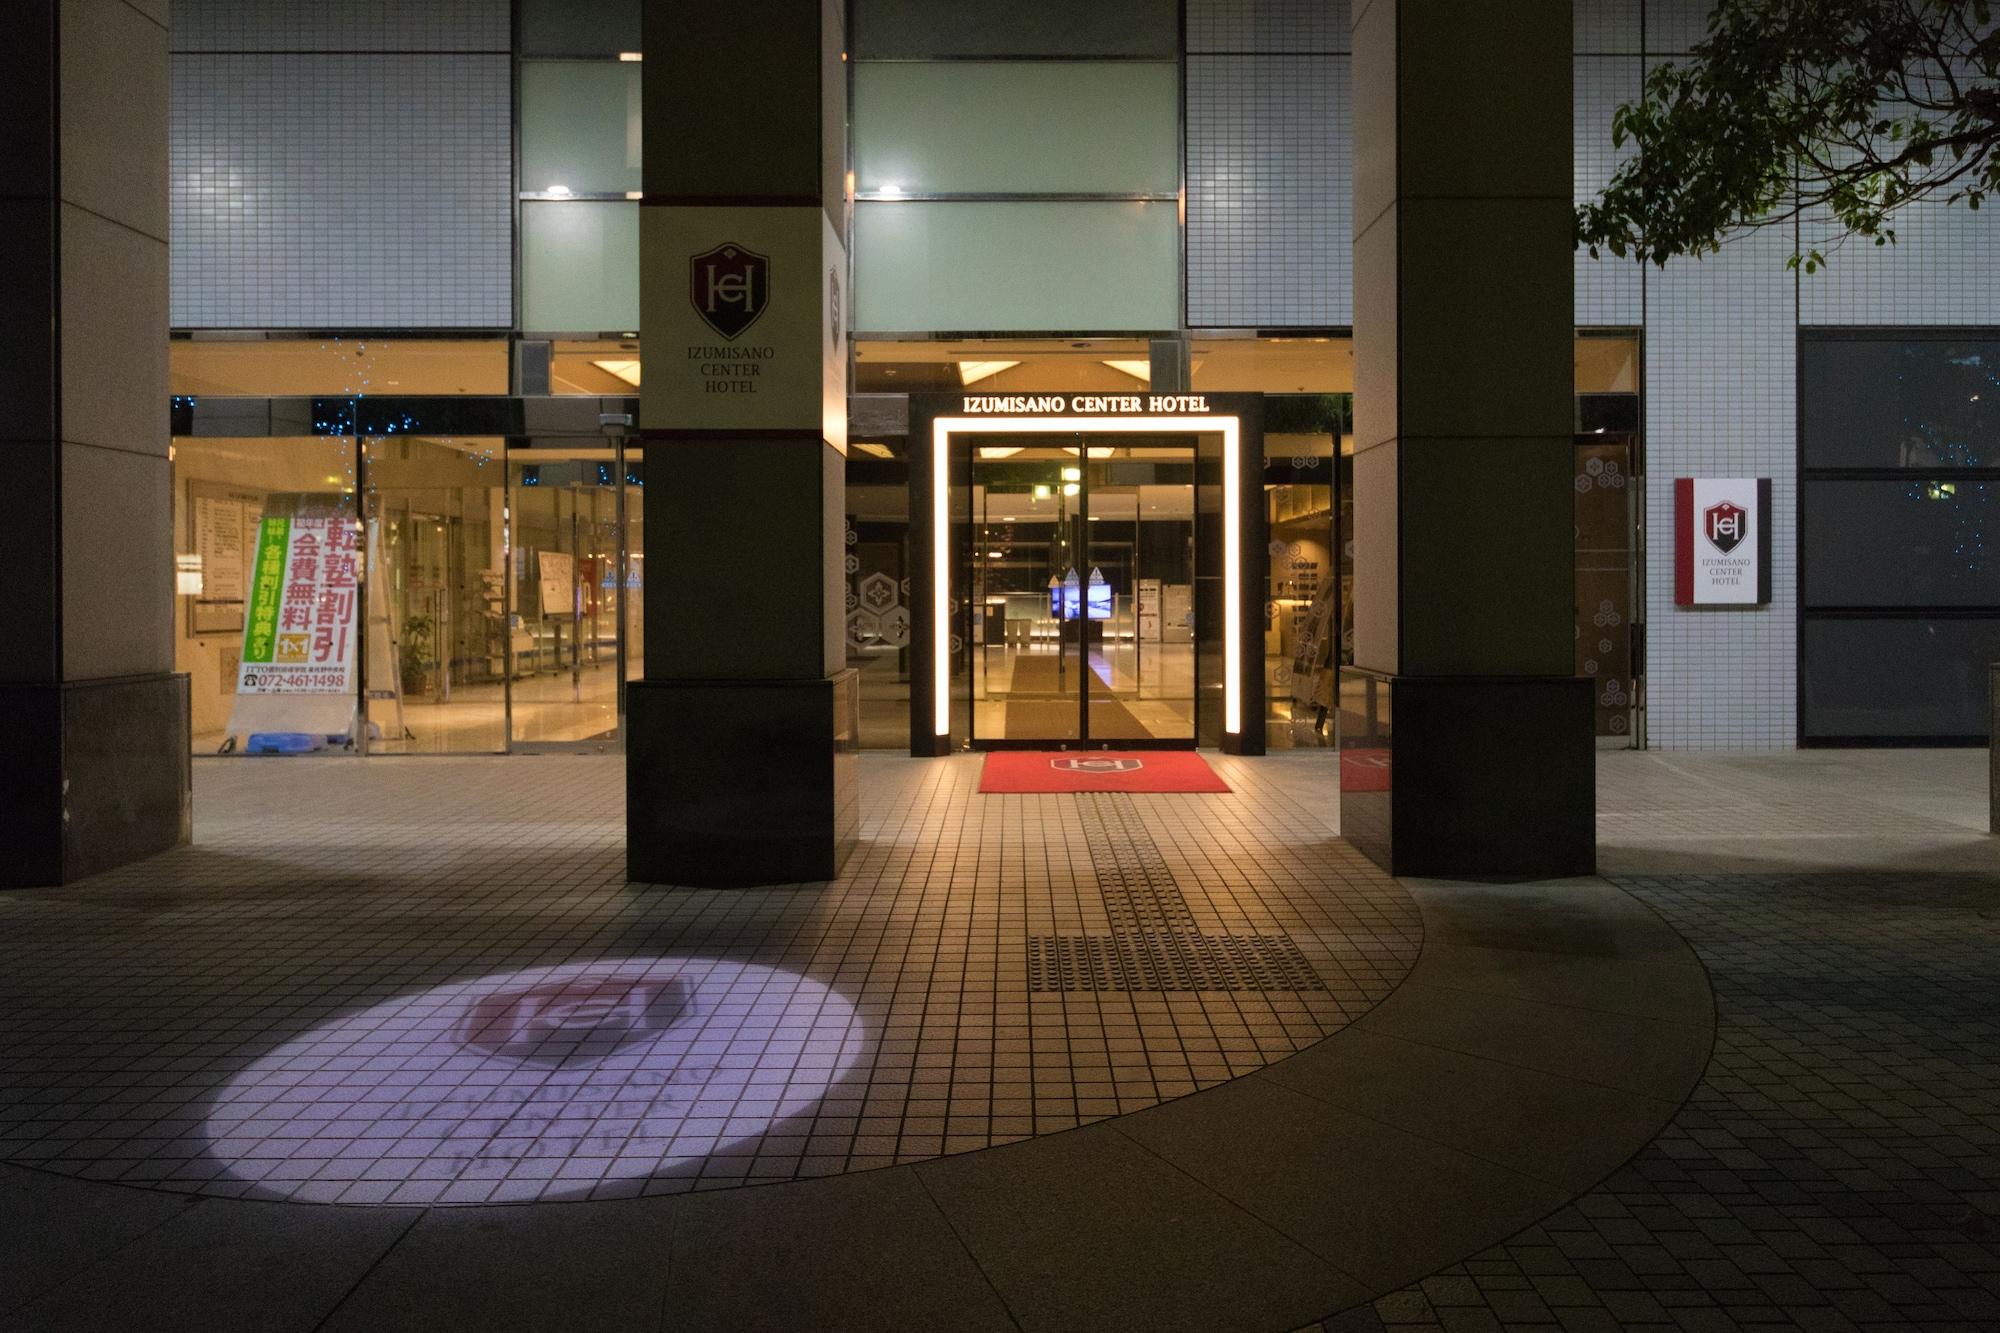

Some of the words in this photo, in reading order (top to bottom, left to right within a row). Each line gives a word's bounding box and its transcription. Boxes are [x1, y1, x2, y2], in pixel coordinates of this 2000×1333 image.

[687, 347, 775, 360] IZUMISANO
[700, 363, 761, 377] CENTER
[705, 381, 757, 394] HOTEL
[963, 396, 1066, 413] IZUMISANO
[1071, 396, 1142, 413] CENTER
[1149, 396, 1210, 413] HOTEL
[1702, 559, 1750, 567] IZUMISANO
[1709, 568, 1743, 577] CENTER
[282, 532, 321, 631] 会費無料
[1712, 578, 1741, 586] HOTEL
